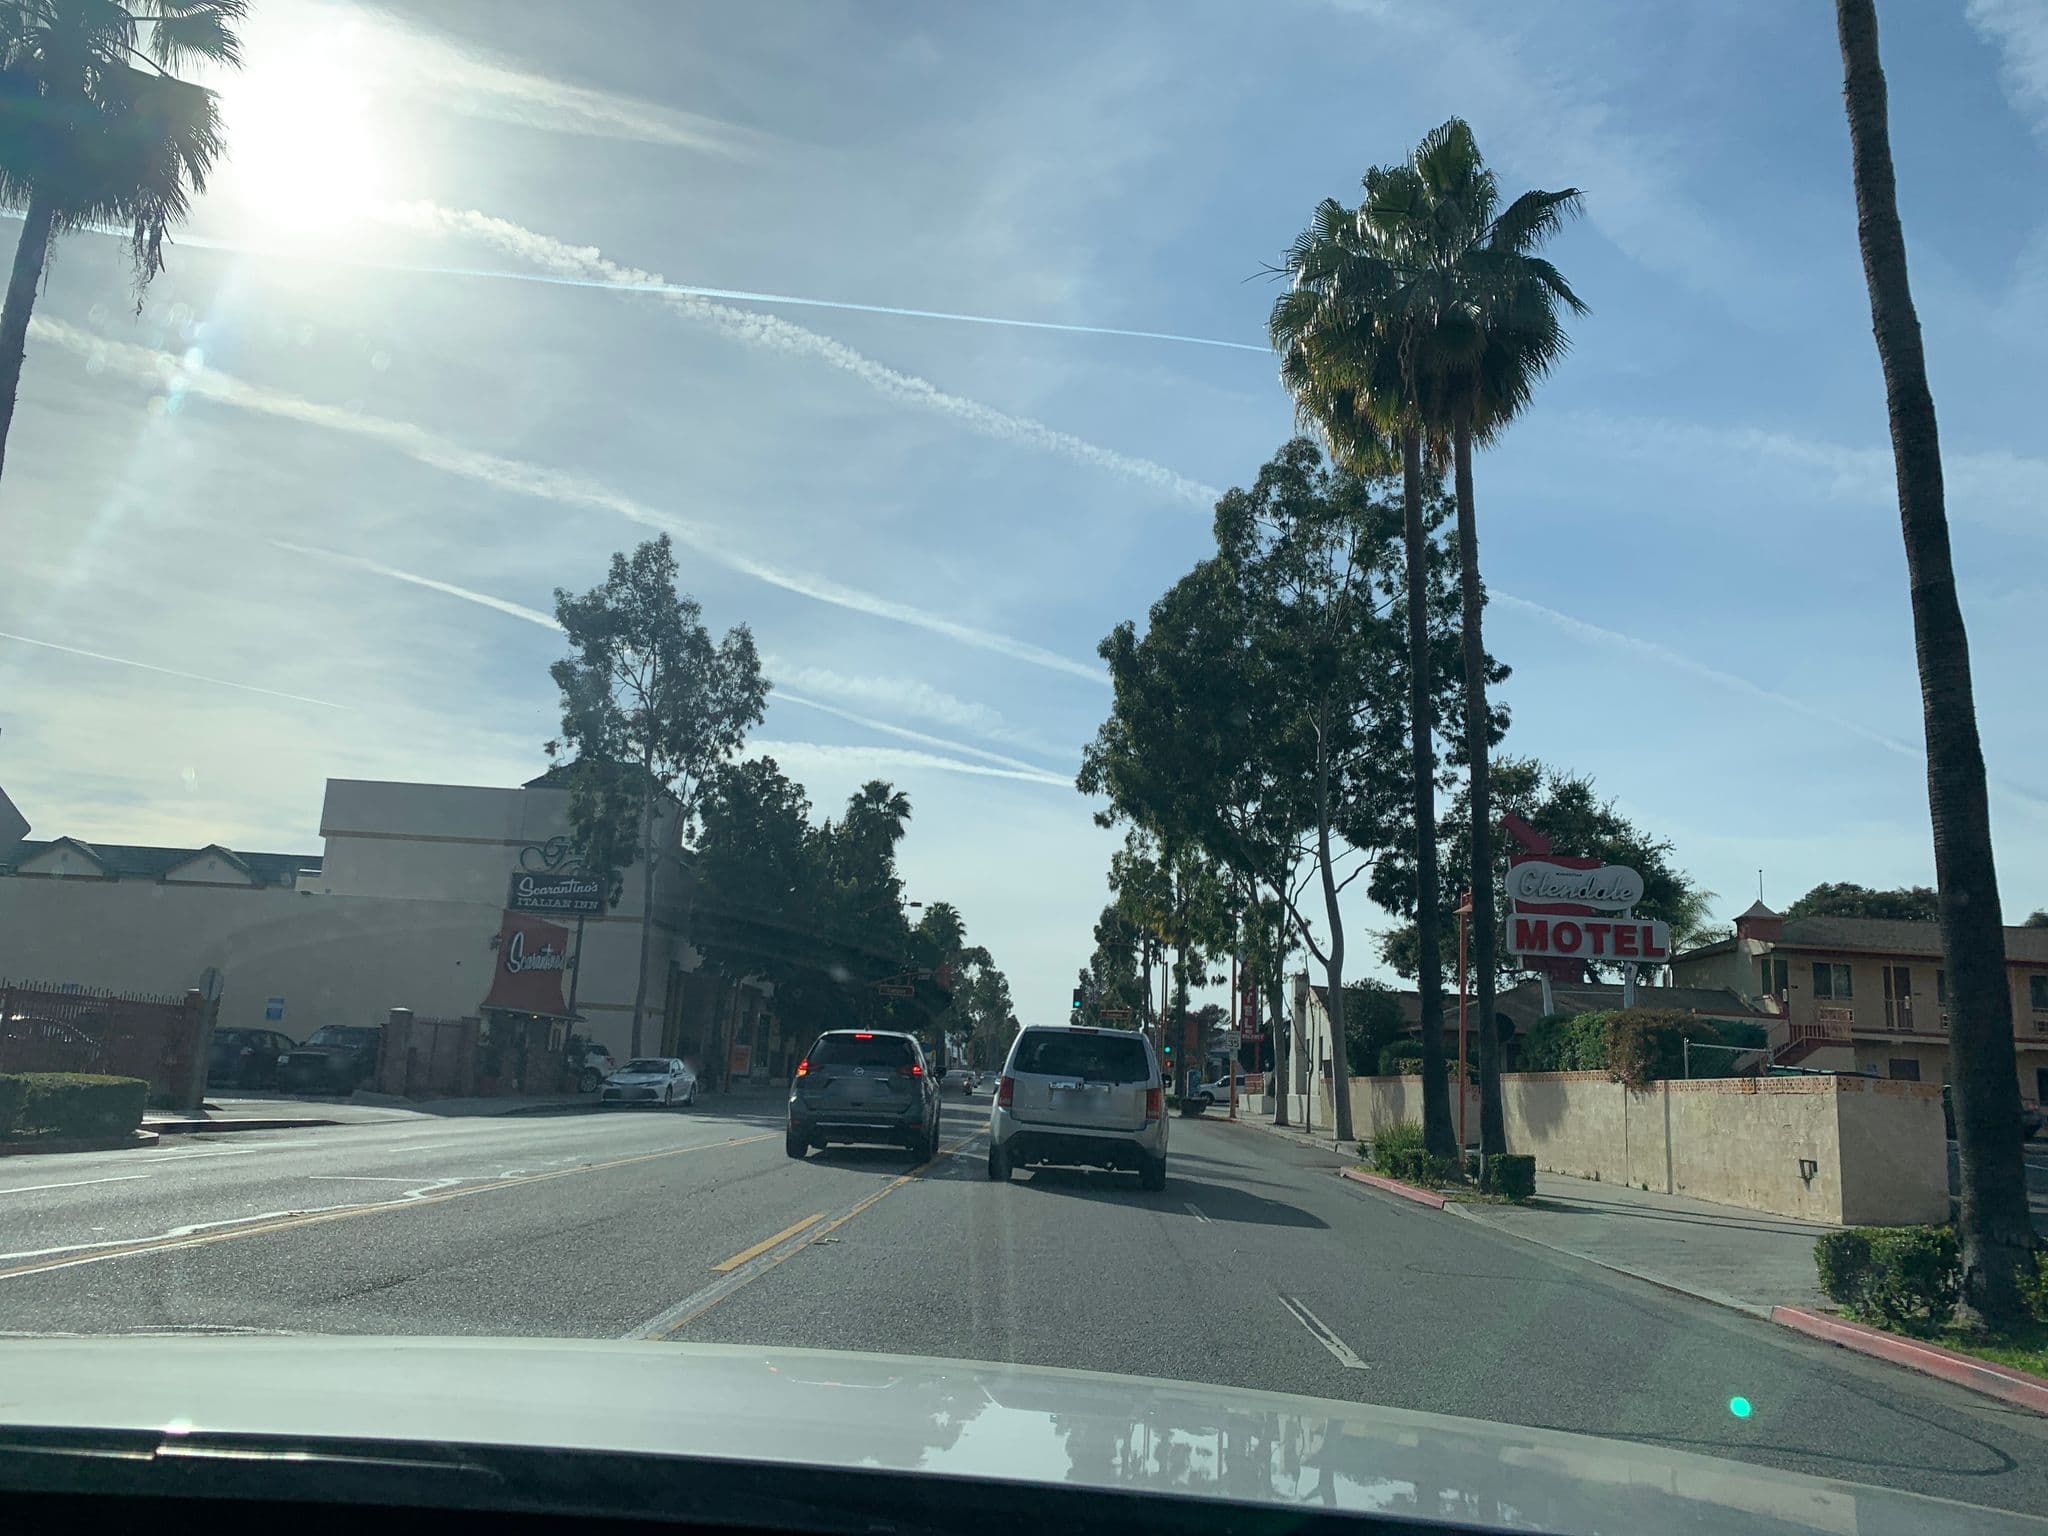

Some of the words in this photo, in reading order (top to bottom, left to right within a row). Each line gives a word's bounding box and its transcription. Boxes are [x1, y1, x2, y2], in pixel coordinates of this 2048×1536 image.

[517, 876, 599, 897] Scarantino's
[1520, 871, 1632, 901] Glendale
[517, 897, 570, 908] ITALIAN
[574, 900, 599, 909] INN
[1515, 919, 1666, 957] MOTEL
